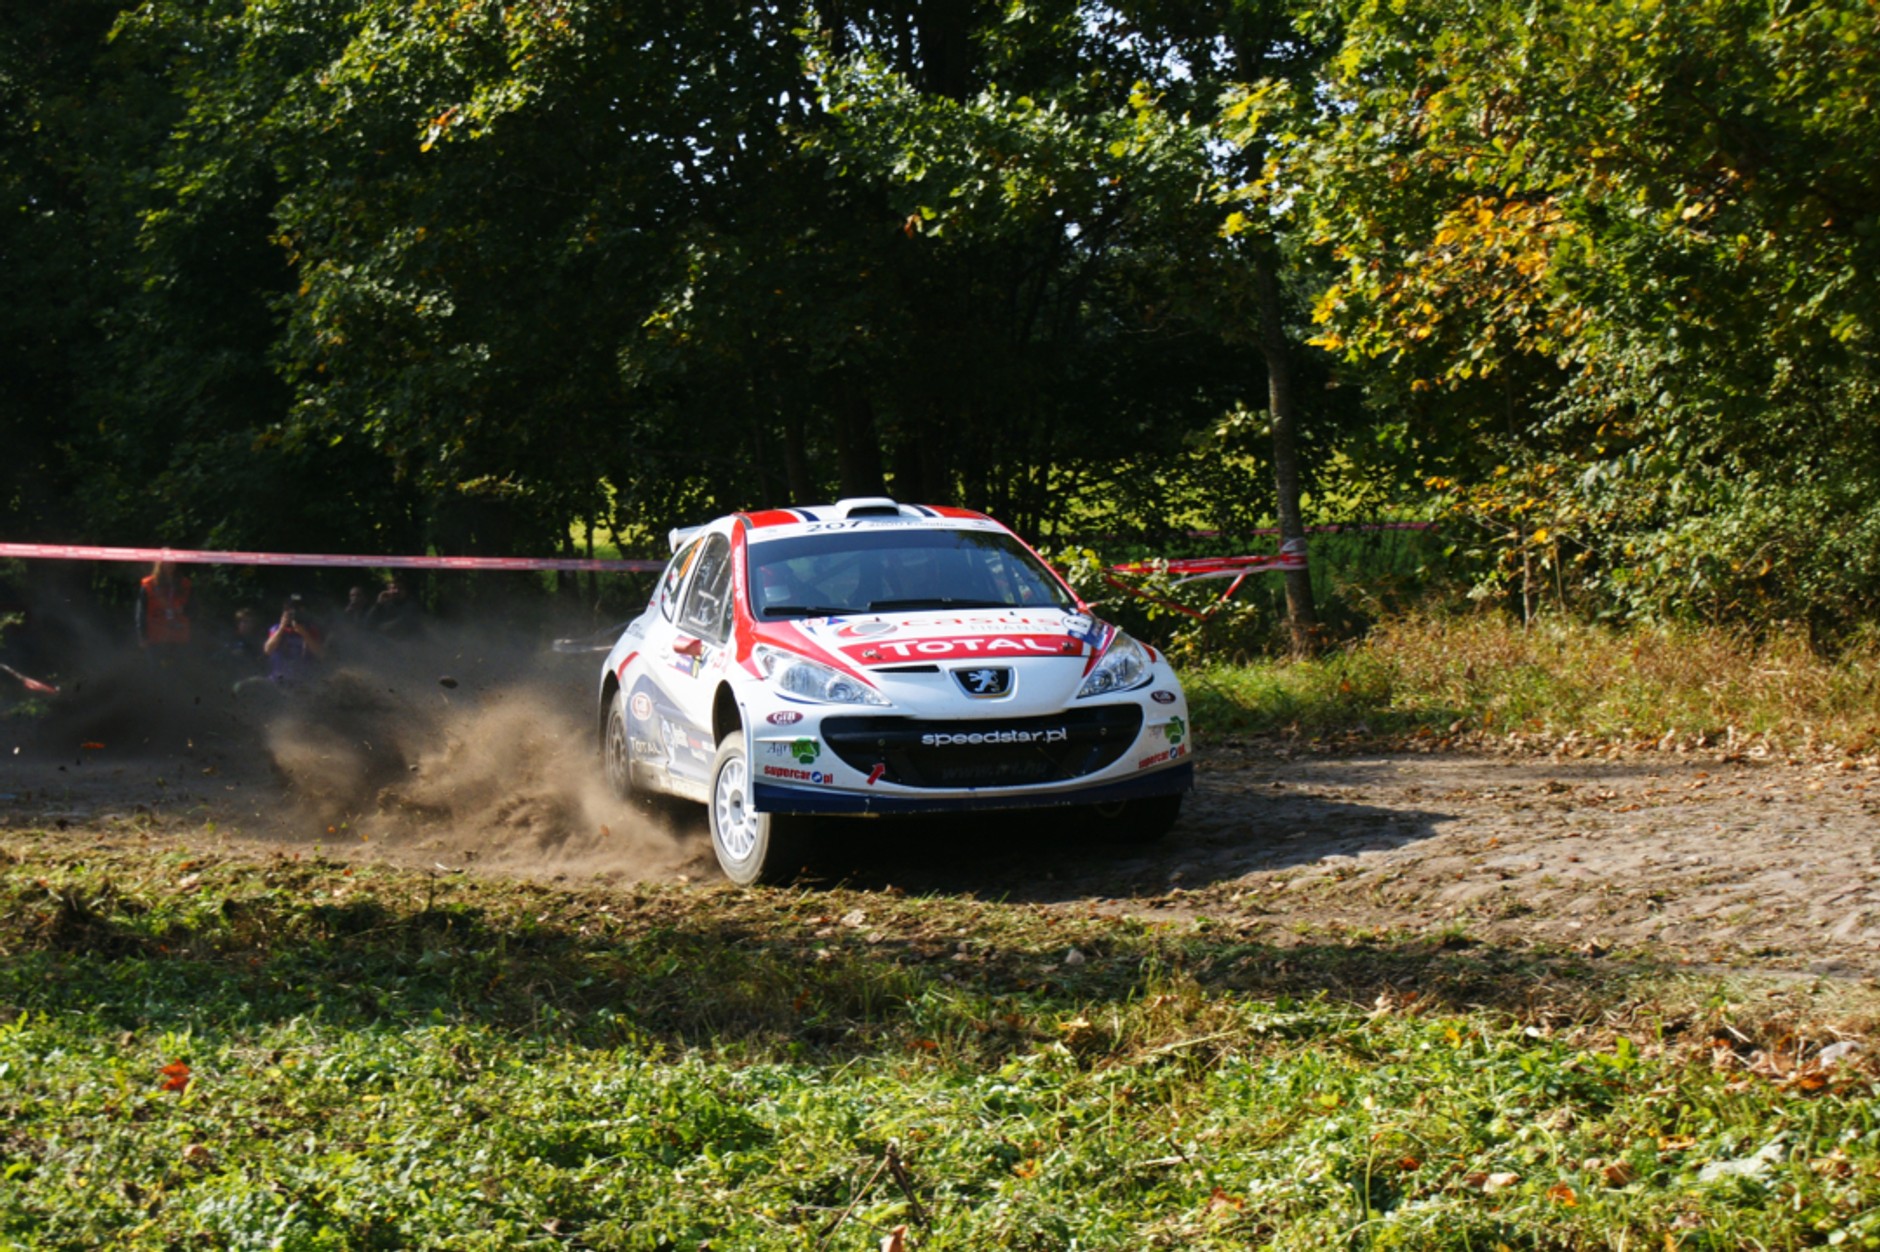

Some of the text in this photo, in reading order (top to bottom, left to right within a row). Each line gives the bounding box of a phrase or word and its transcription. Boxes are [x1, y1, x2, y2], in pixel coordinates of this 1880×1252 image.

[805, 520, 862, 533] 207
[879, 638, 1058, 657] TOTAL
[629, 736, 662, 755] TOTAL
[921, 727, 1068, 747] speedstar.pl
[764, 765, 811, 781] supercar
